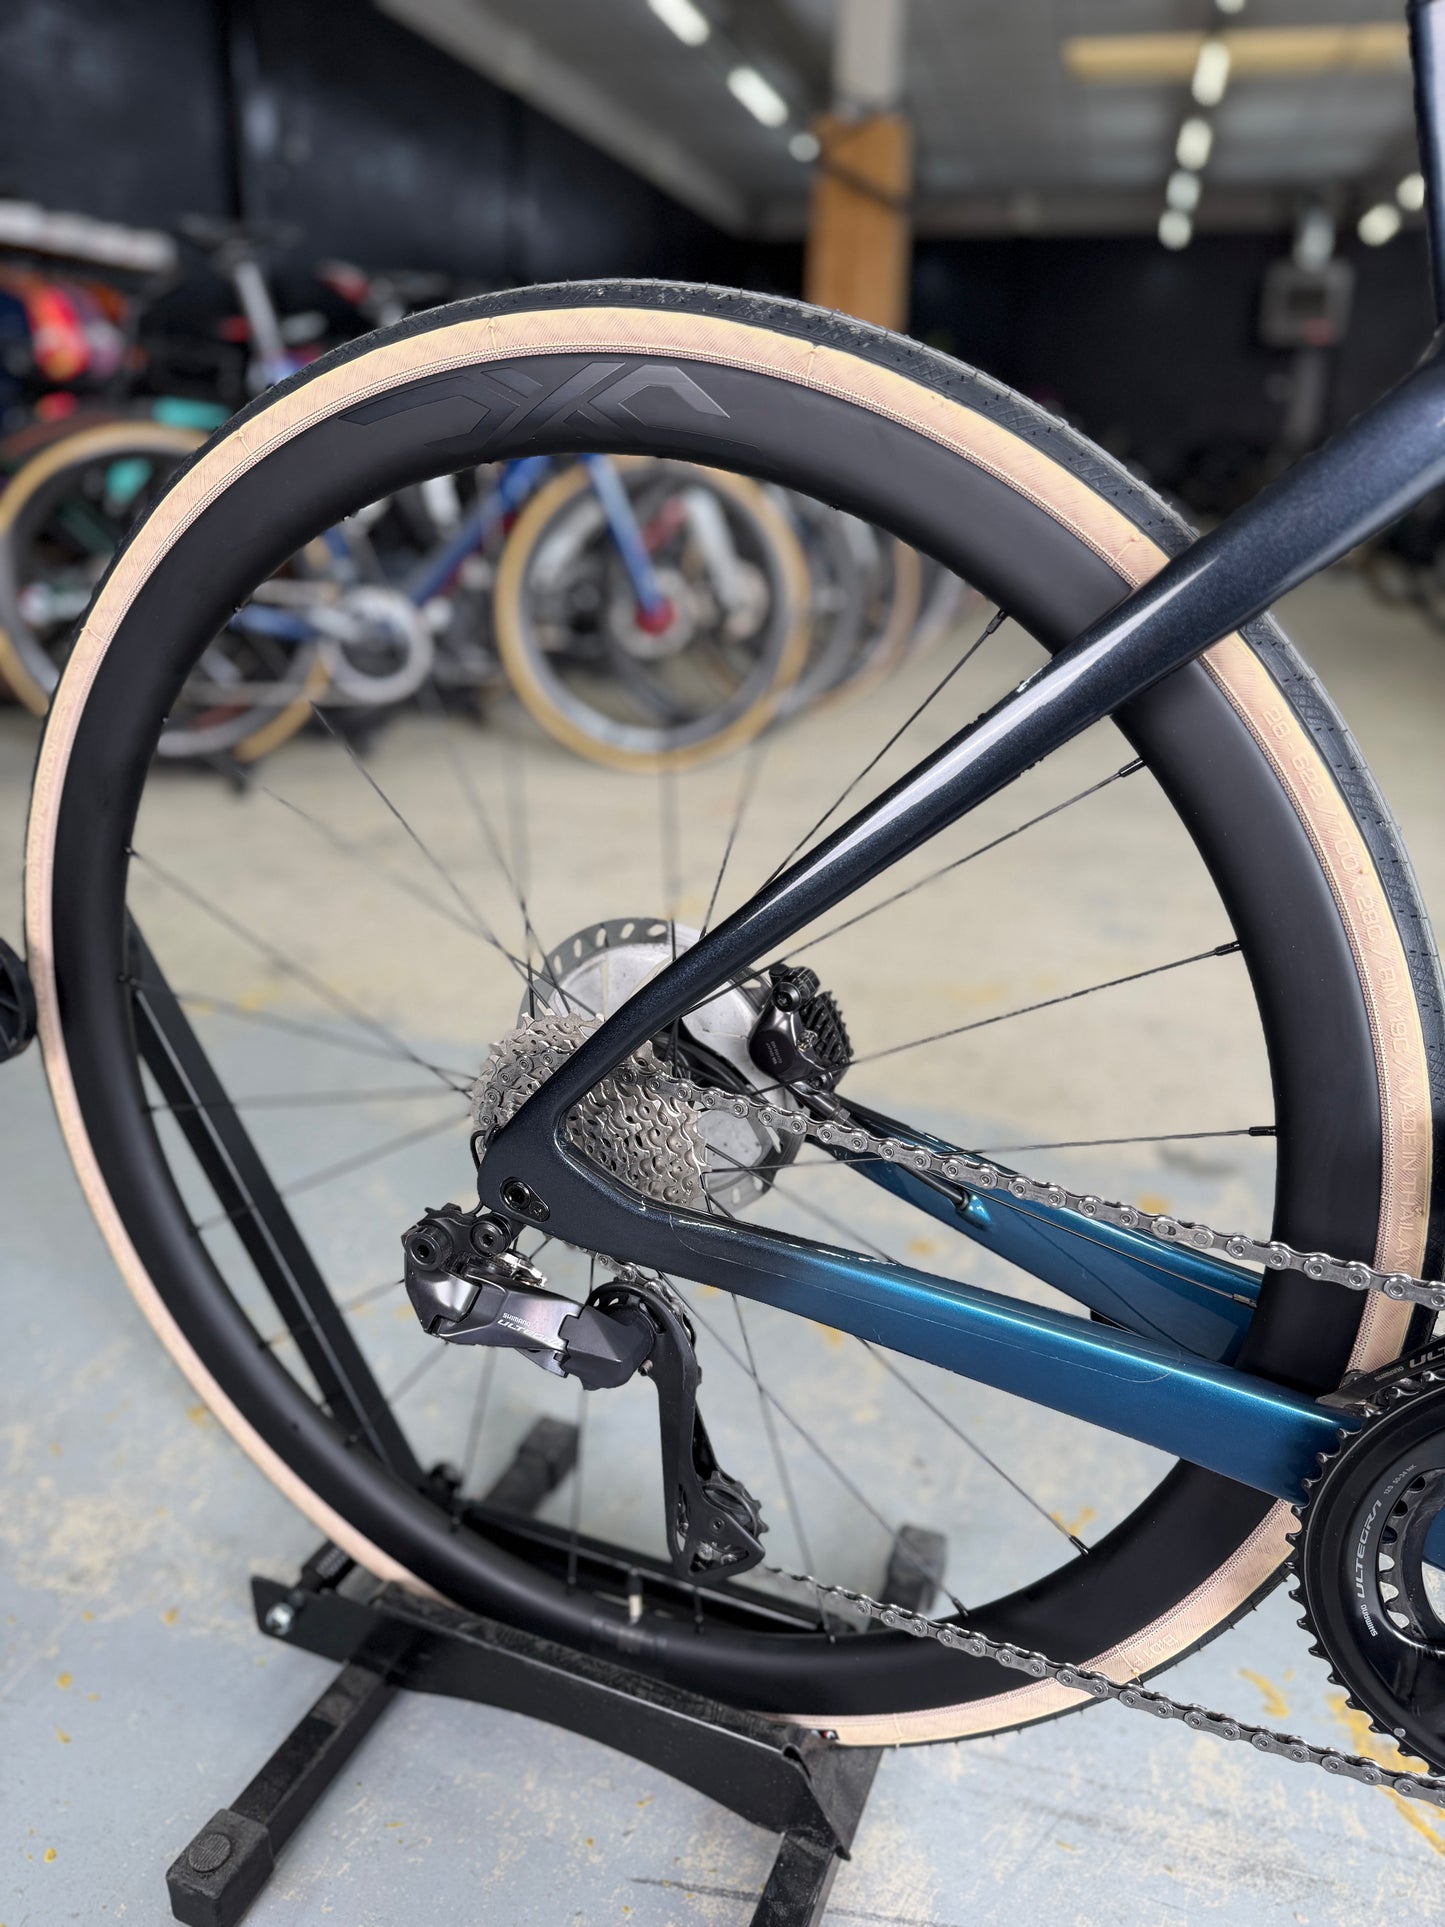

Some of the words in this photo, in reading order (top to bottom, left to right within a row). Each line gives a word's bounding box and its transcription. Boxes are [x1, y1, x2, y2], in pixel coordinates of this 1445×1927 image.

[1262, 707, 1291, 740] 28
[1292, 754, 1326, 801] 622
[1327, 823, 1359, 873] 700
[1399, 1078, 1417, 1146] MADE
[1401, 1152, 1417, 1171] IN
[1394, 1177, 1417, 1273] THAILAN
[502, 1312, 531, 1327] SHIMANO
[1355, 1499, 1382, 1599] ULTEGRA
[1360, 1604, 1379, 1637] SHIMANO
